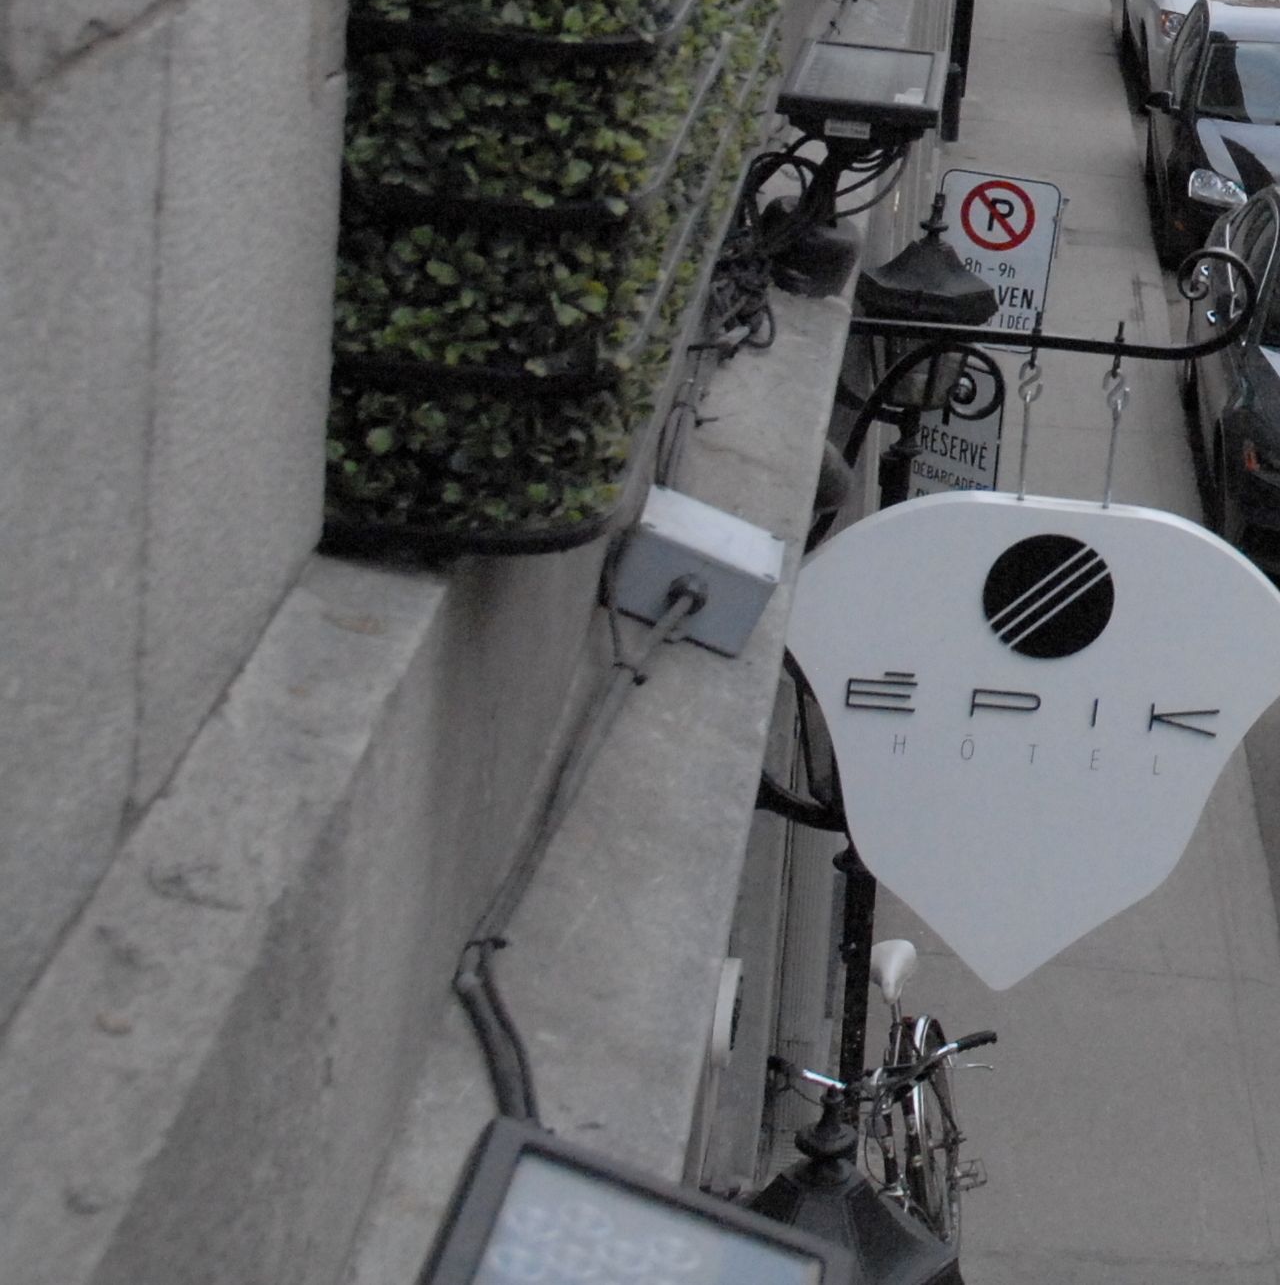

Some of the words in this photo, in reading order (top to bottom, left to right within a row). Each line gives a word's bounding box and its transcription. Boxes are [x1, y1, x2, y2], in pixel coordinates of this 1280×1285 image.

[964, 256, 982, 274] 8h
[999, 262, 1016, 279] 9h
[920, 424, 988, 472] RÉSERVÉ
